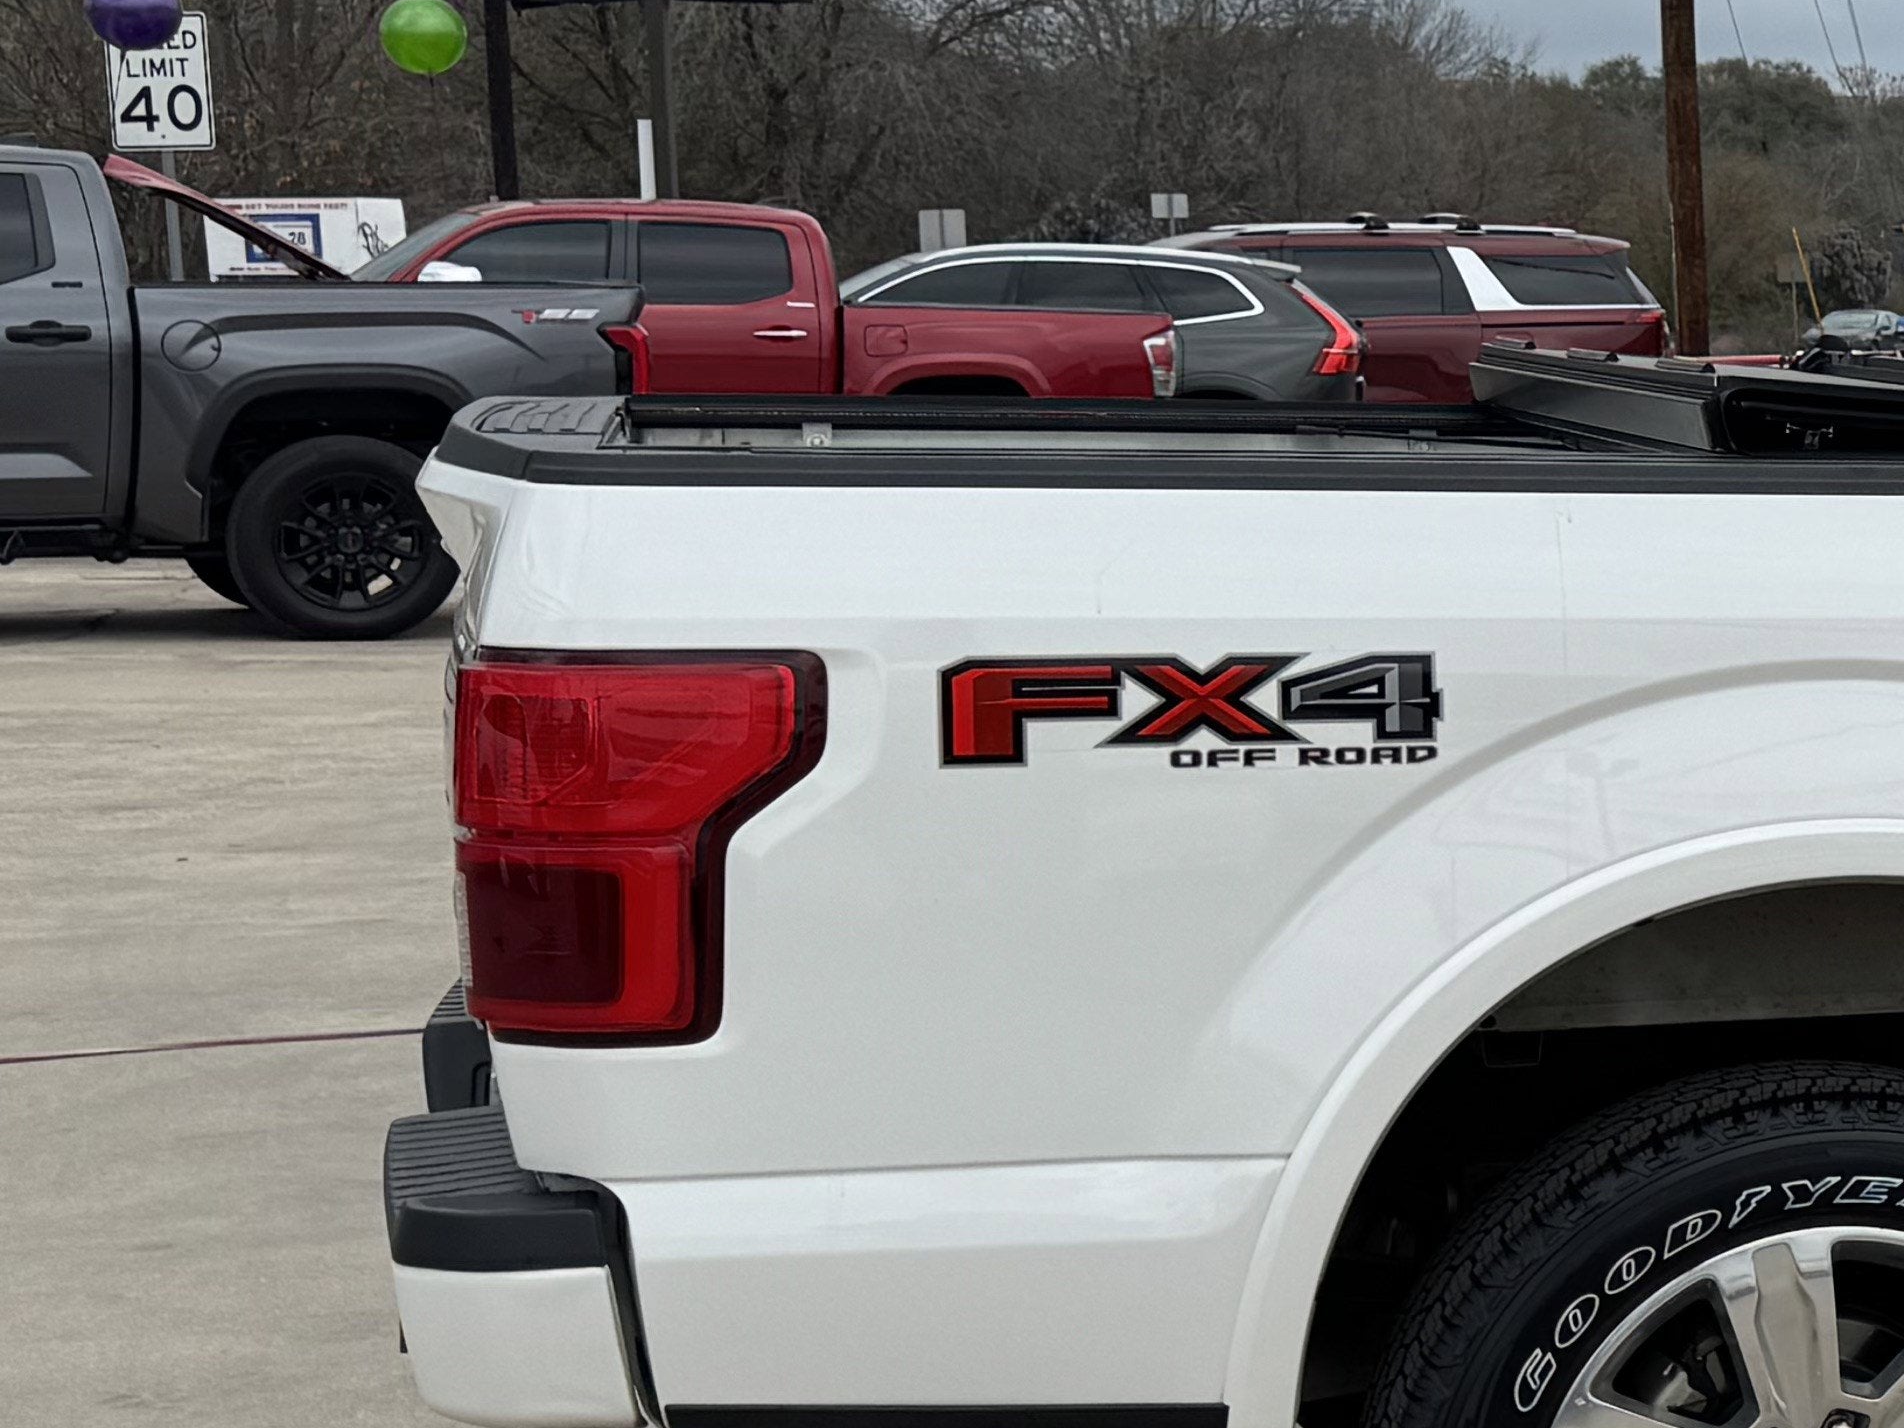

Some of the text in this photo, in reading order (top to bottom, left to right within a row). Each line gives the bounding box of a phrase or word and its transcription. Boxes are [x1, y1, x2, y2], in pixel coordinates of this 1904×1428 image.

[126, 58, 188, 77] LIMIT
[121, 84, 202, 131] 40
[937, 651, 1443, 769] FX4
[1169, 745, 1438, 768] OFF ROAD
